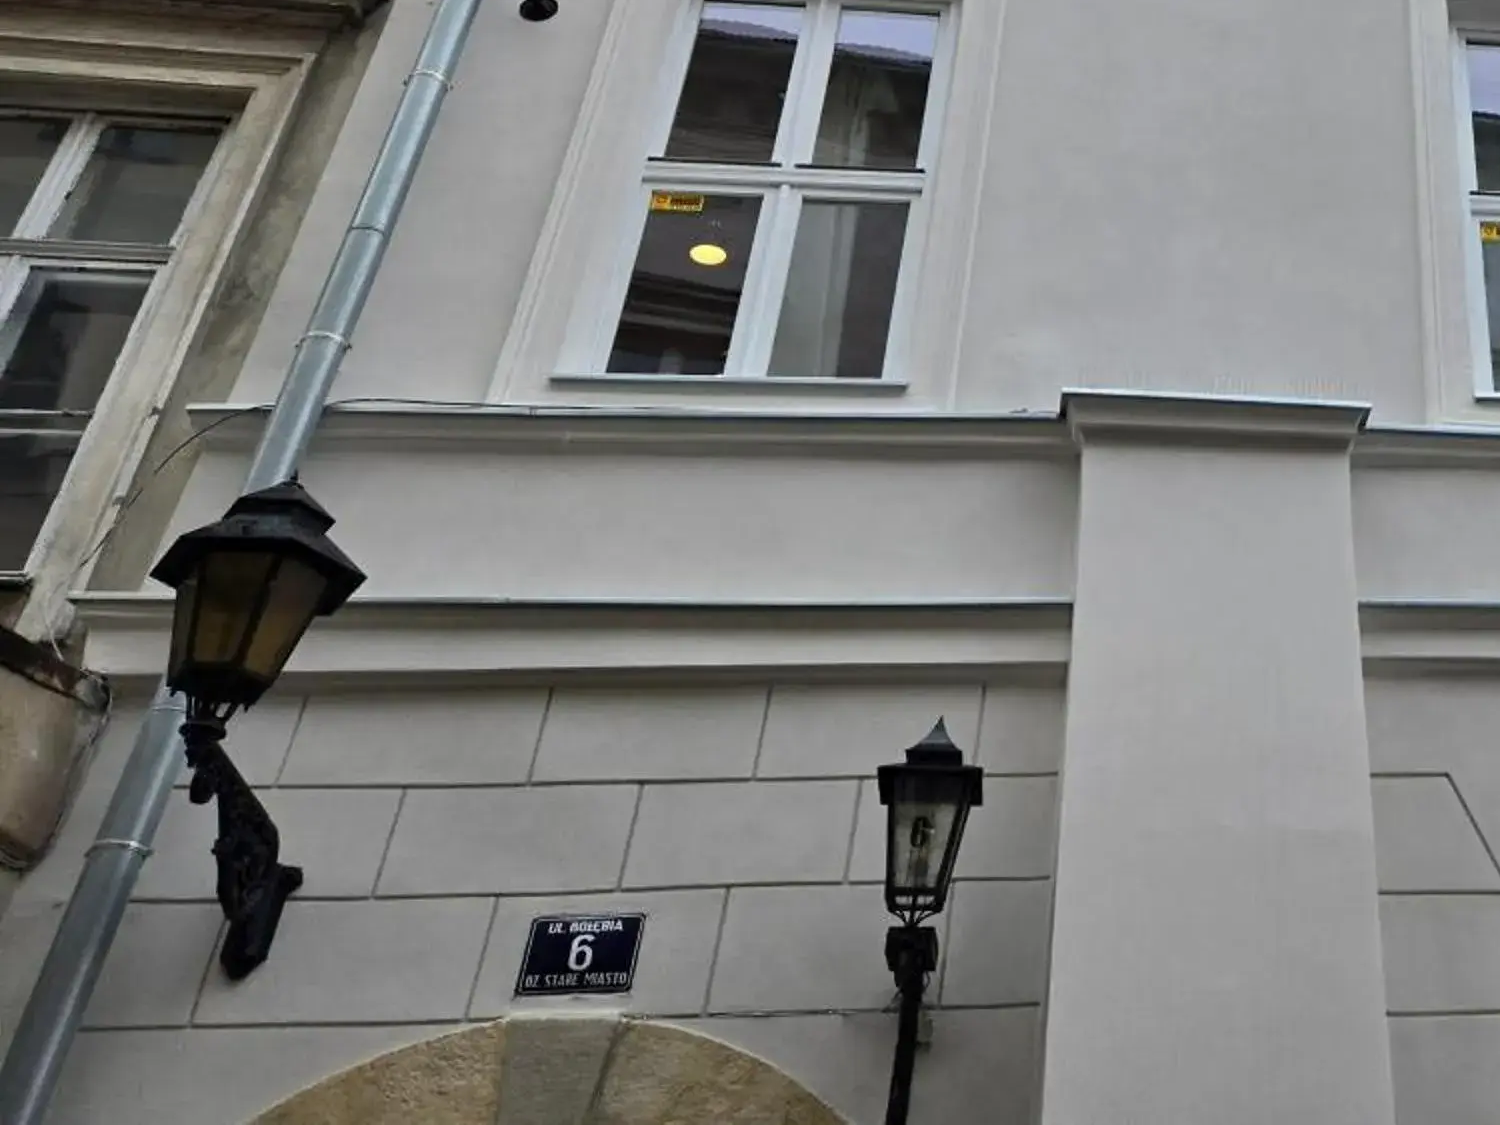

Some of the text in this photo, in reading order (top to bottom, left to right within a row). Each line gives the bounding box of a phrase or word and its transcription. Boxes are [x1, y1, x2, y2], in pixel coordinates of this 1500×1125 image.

[568, 934, 596, 971] 6
[545, 973, 580, 987] STARE
[584, 972, 627, 986] MIASTO
